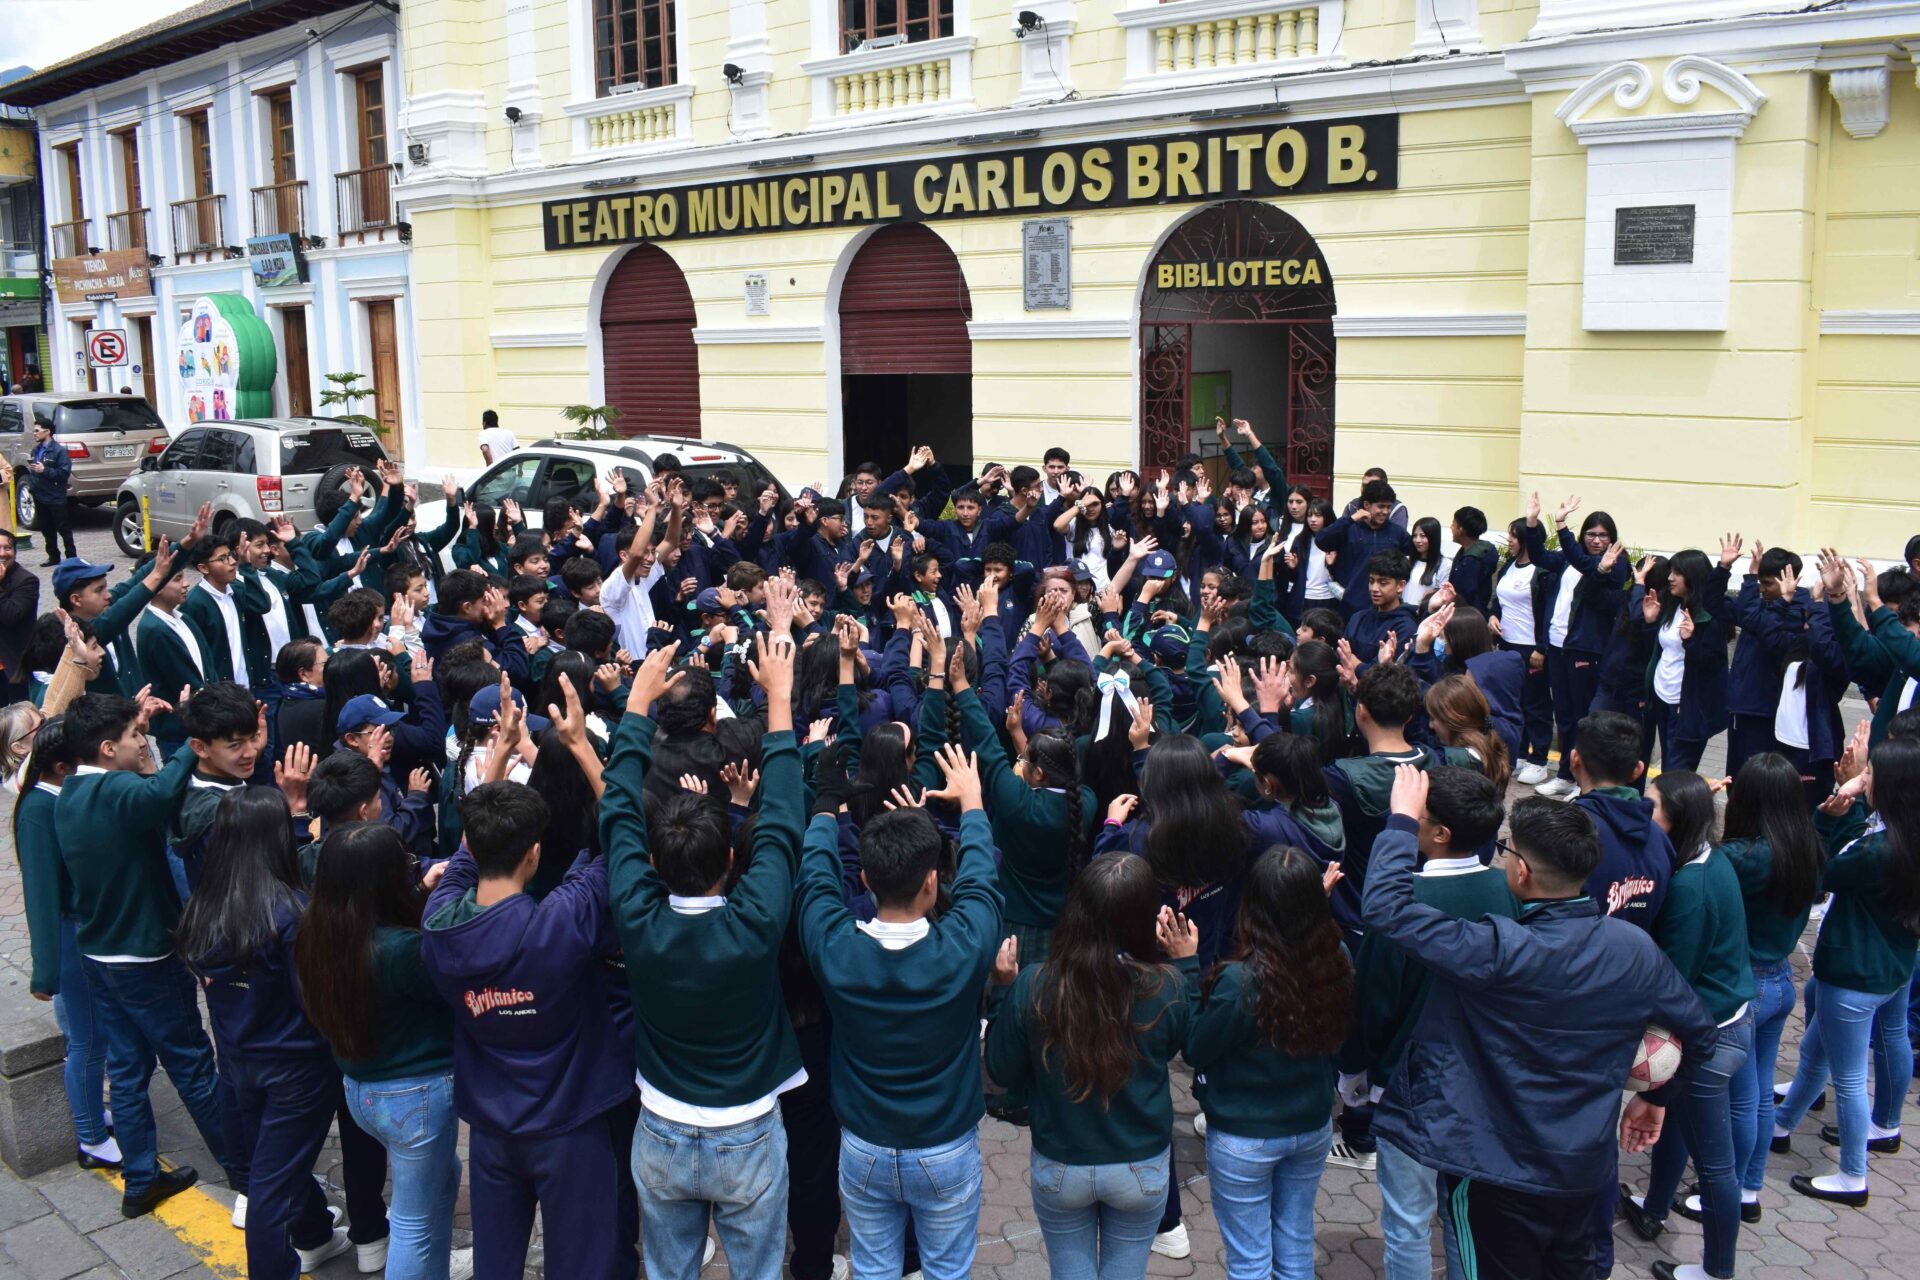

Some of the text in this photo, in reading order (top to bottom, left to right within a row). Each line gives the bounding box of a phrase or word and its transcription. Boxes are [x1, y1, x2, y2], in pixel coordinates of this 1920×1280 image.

[551, 124, 1378, 245] TEATRO MUNICIPAL CARLOS BRITO B.
[84, 258, 108, 273] TIENDA
[1157, 258, 1322, 288] BIBLIOTECA
[73, 277, 104, 291] PICHINCHA
[514, 1008, 537, 1016] ANDES
